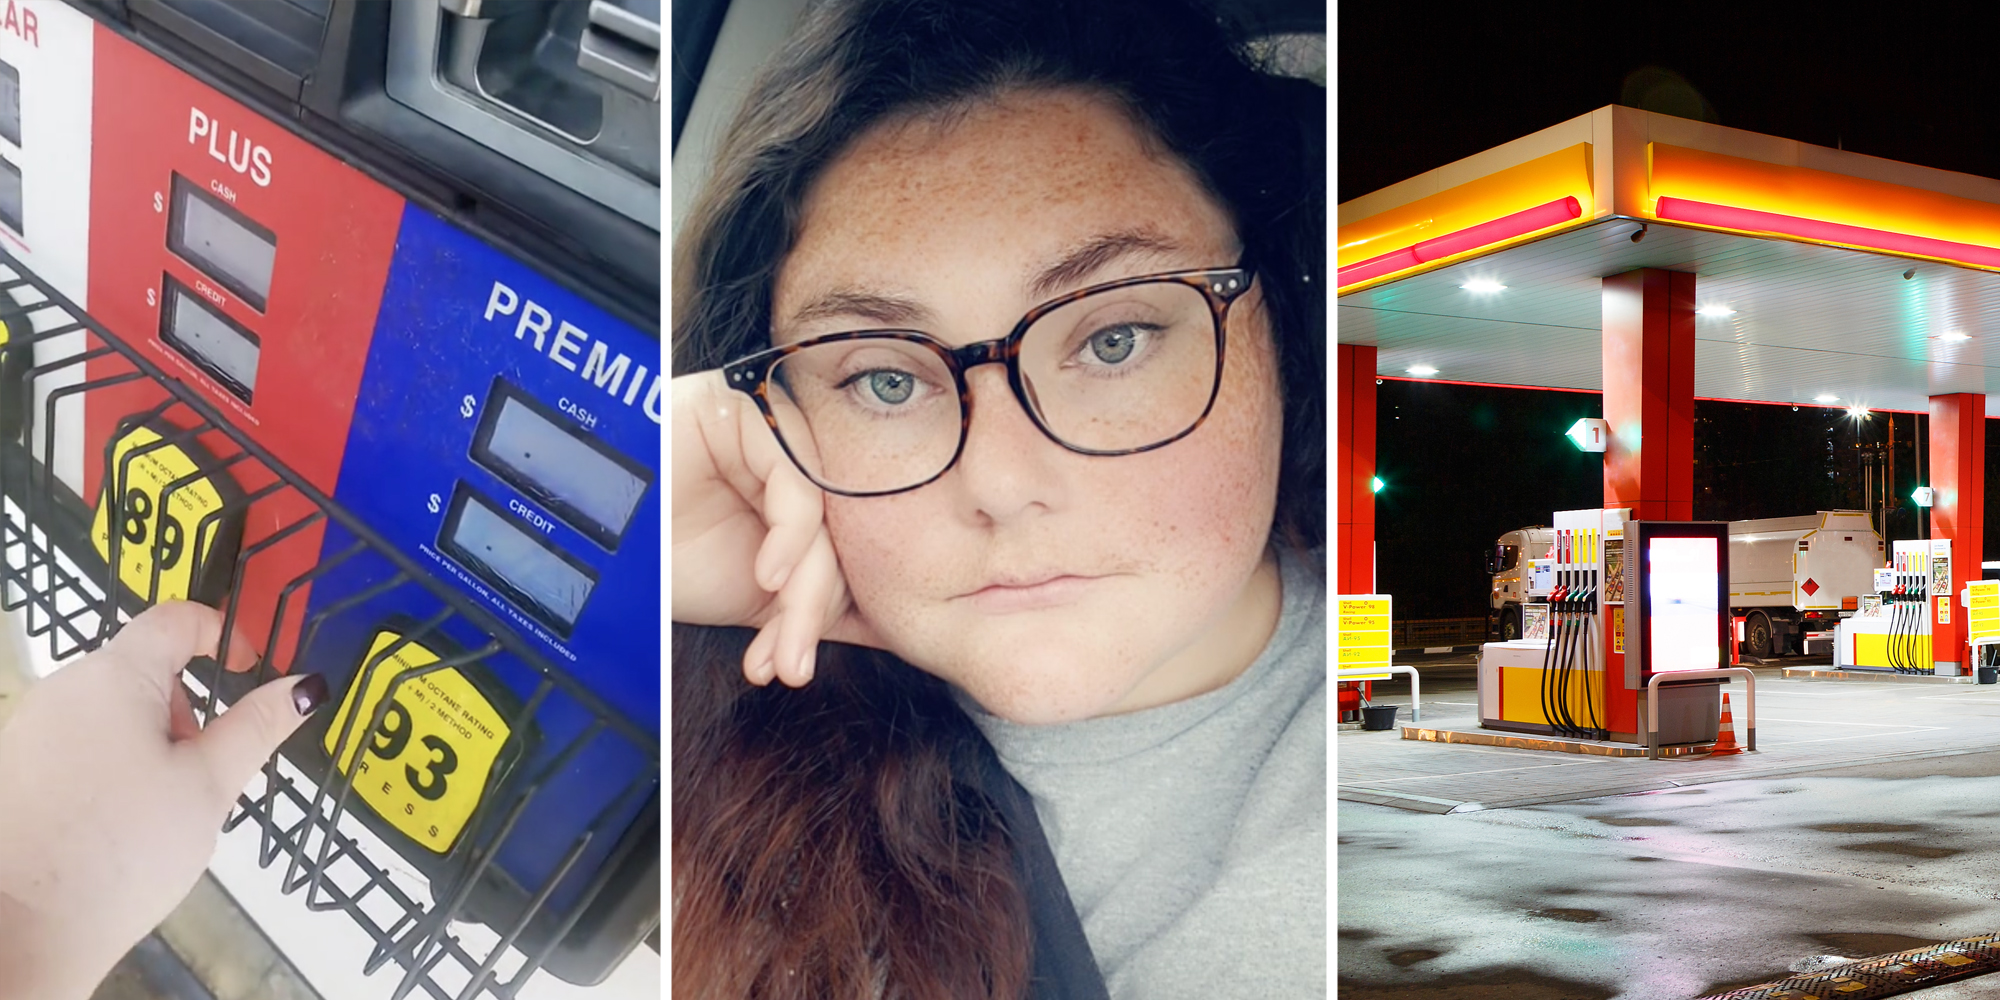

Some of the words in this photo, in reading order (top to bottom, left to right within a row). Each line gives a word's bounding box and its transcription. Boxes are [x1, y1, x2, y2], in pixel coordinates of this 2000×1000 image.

[0, 0, 38, 48] AR
[188, 106, 273, 187] PLUS
[210, 179, 236, 203] CASH
[195, 280, 226, 307] CREDIT
[460, 394, 477, 419] $
[557, 397, 598, 428] CASH
[1592, 427, 1599, 443] 1
[427, 493, 442, 514] $
[1925, 492, 1930, 501] 7
[122, 487, 184, 571] 89
[509, 499, 556, 534] CREDIT
[419, 543, 440, 562] PRICE
[441, 560, 457, 575] PER
[491, 597, 506, 612] ALL
[508, 608, 533, 631] TAXES
[534, 628, 577, 662] INCLUDED
[393, 653, 427, 684] MINIM
[427, 682, 461, 712] OCTANE
[462, 710, 495, 740] RATING
[429, 702, 436, 710] 2
[437, 708, 472, 740] METHOD
[364, 698, 458, 801] 93
[350, 752, 439, 838] RESS
